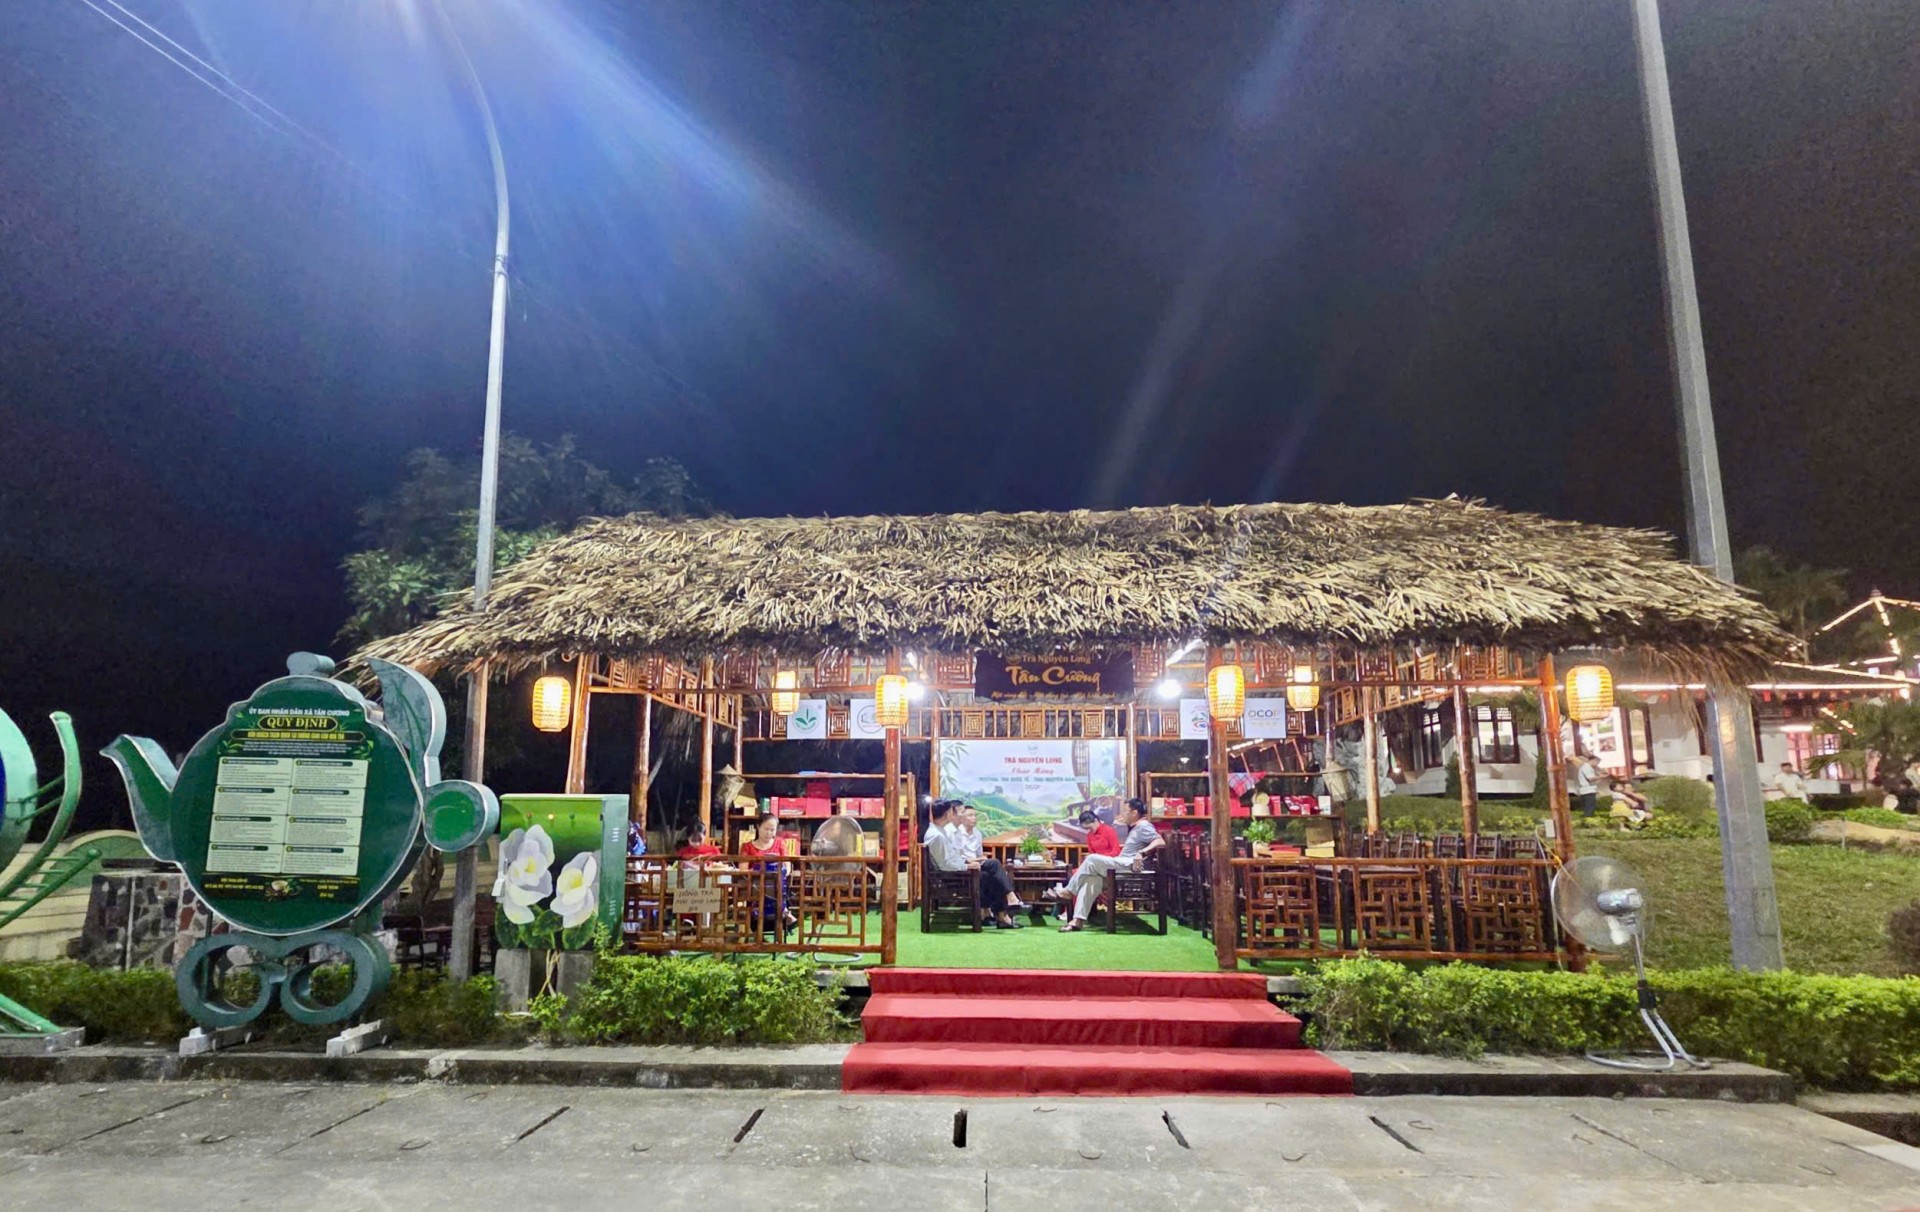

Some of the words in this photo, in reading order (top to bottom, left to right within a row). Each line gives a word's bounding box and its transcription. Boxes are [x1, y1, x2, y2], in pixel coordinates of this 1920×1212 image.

[1005, 666, 1040, 686] Tân
[266, 717, 293, 729] QUY
[295, 717, 329, 729] ĐỊNH
